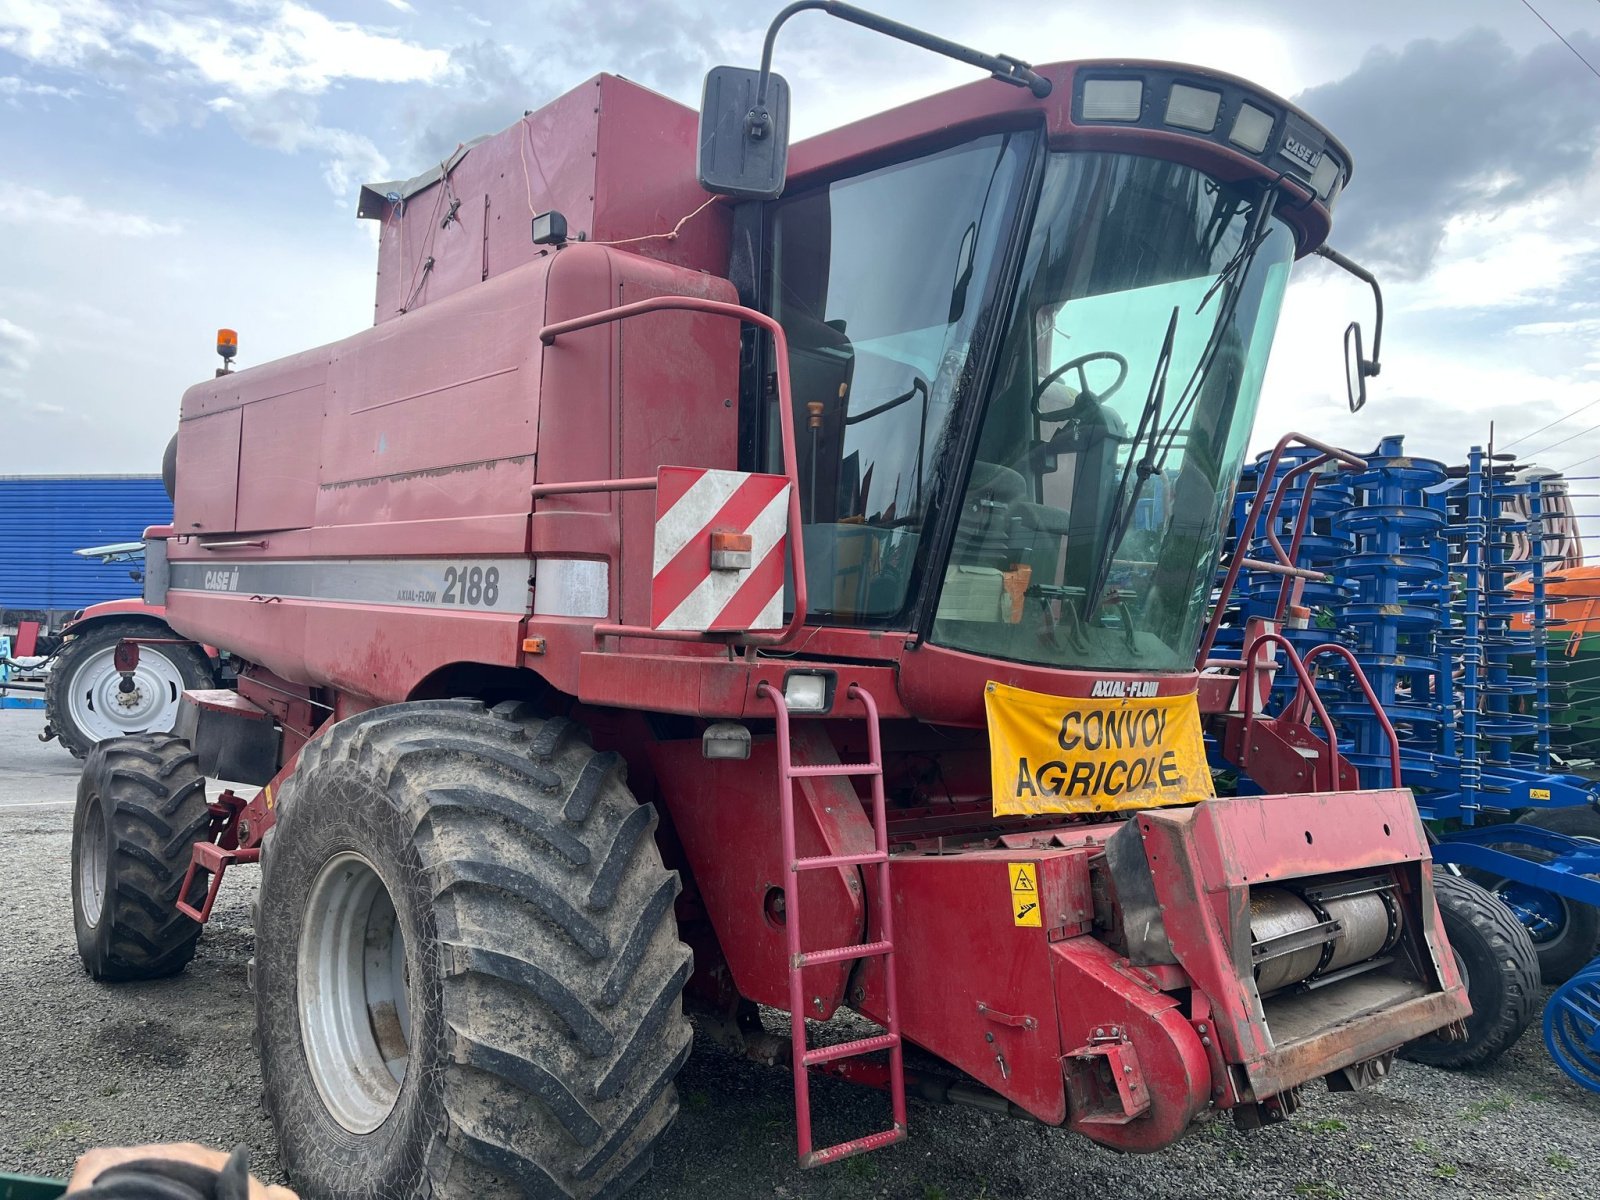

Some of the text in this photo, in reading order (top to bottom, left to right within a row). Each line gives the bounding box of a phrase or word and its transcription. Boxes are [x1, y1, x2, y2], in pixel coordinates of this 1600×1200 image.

[1285, 136, 1312, 162] CASE
[205, 570, 230, 591] CASE
[441, 566, 500, 607] 2188
[1057, 708, 1168, 751] CONVOI
[1016, 750, 1183, 798] AGRICOLE
